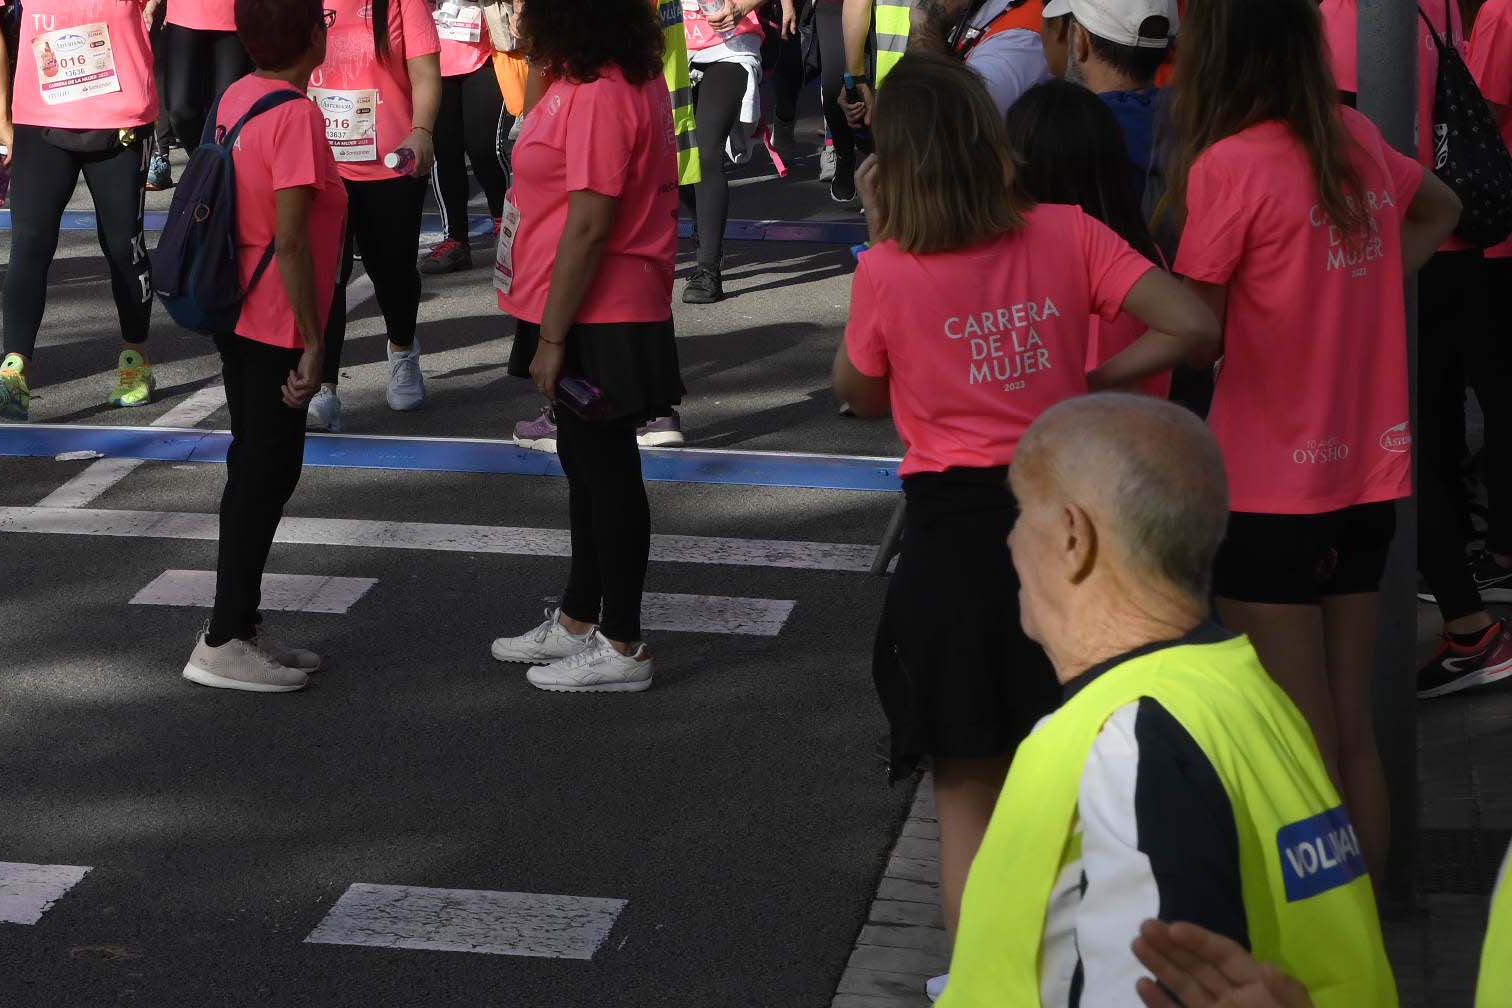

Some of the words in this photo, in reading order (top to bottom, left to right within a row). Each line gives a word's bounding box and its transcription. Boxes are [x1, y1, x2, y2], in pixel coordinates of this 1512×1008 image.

[31, 14, 55, 31] TU
[60, 55, 86, 68] 016
[311, 69, 323, 87] U
[324, 118, 350, 129] 016
[944, 296, 1061, 340] CARRERA
[970, 335, 1004, 361] DE
[1011, 329, 1043, 353] LA
[969, 348, 1052, 385] MUJER
[1003, 380, 1027, 392] 2023
[1292, 444, 1349, 465] OYSHO
